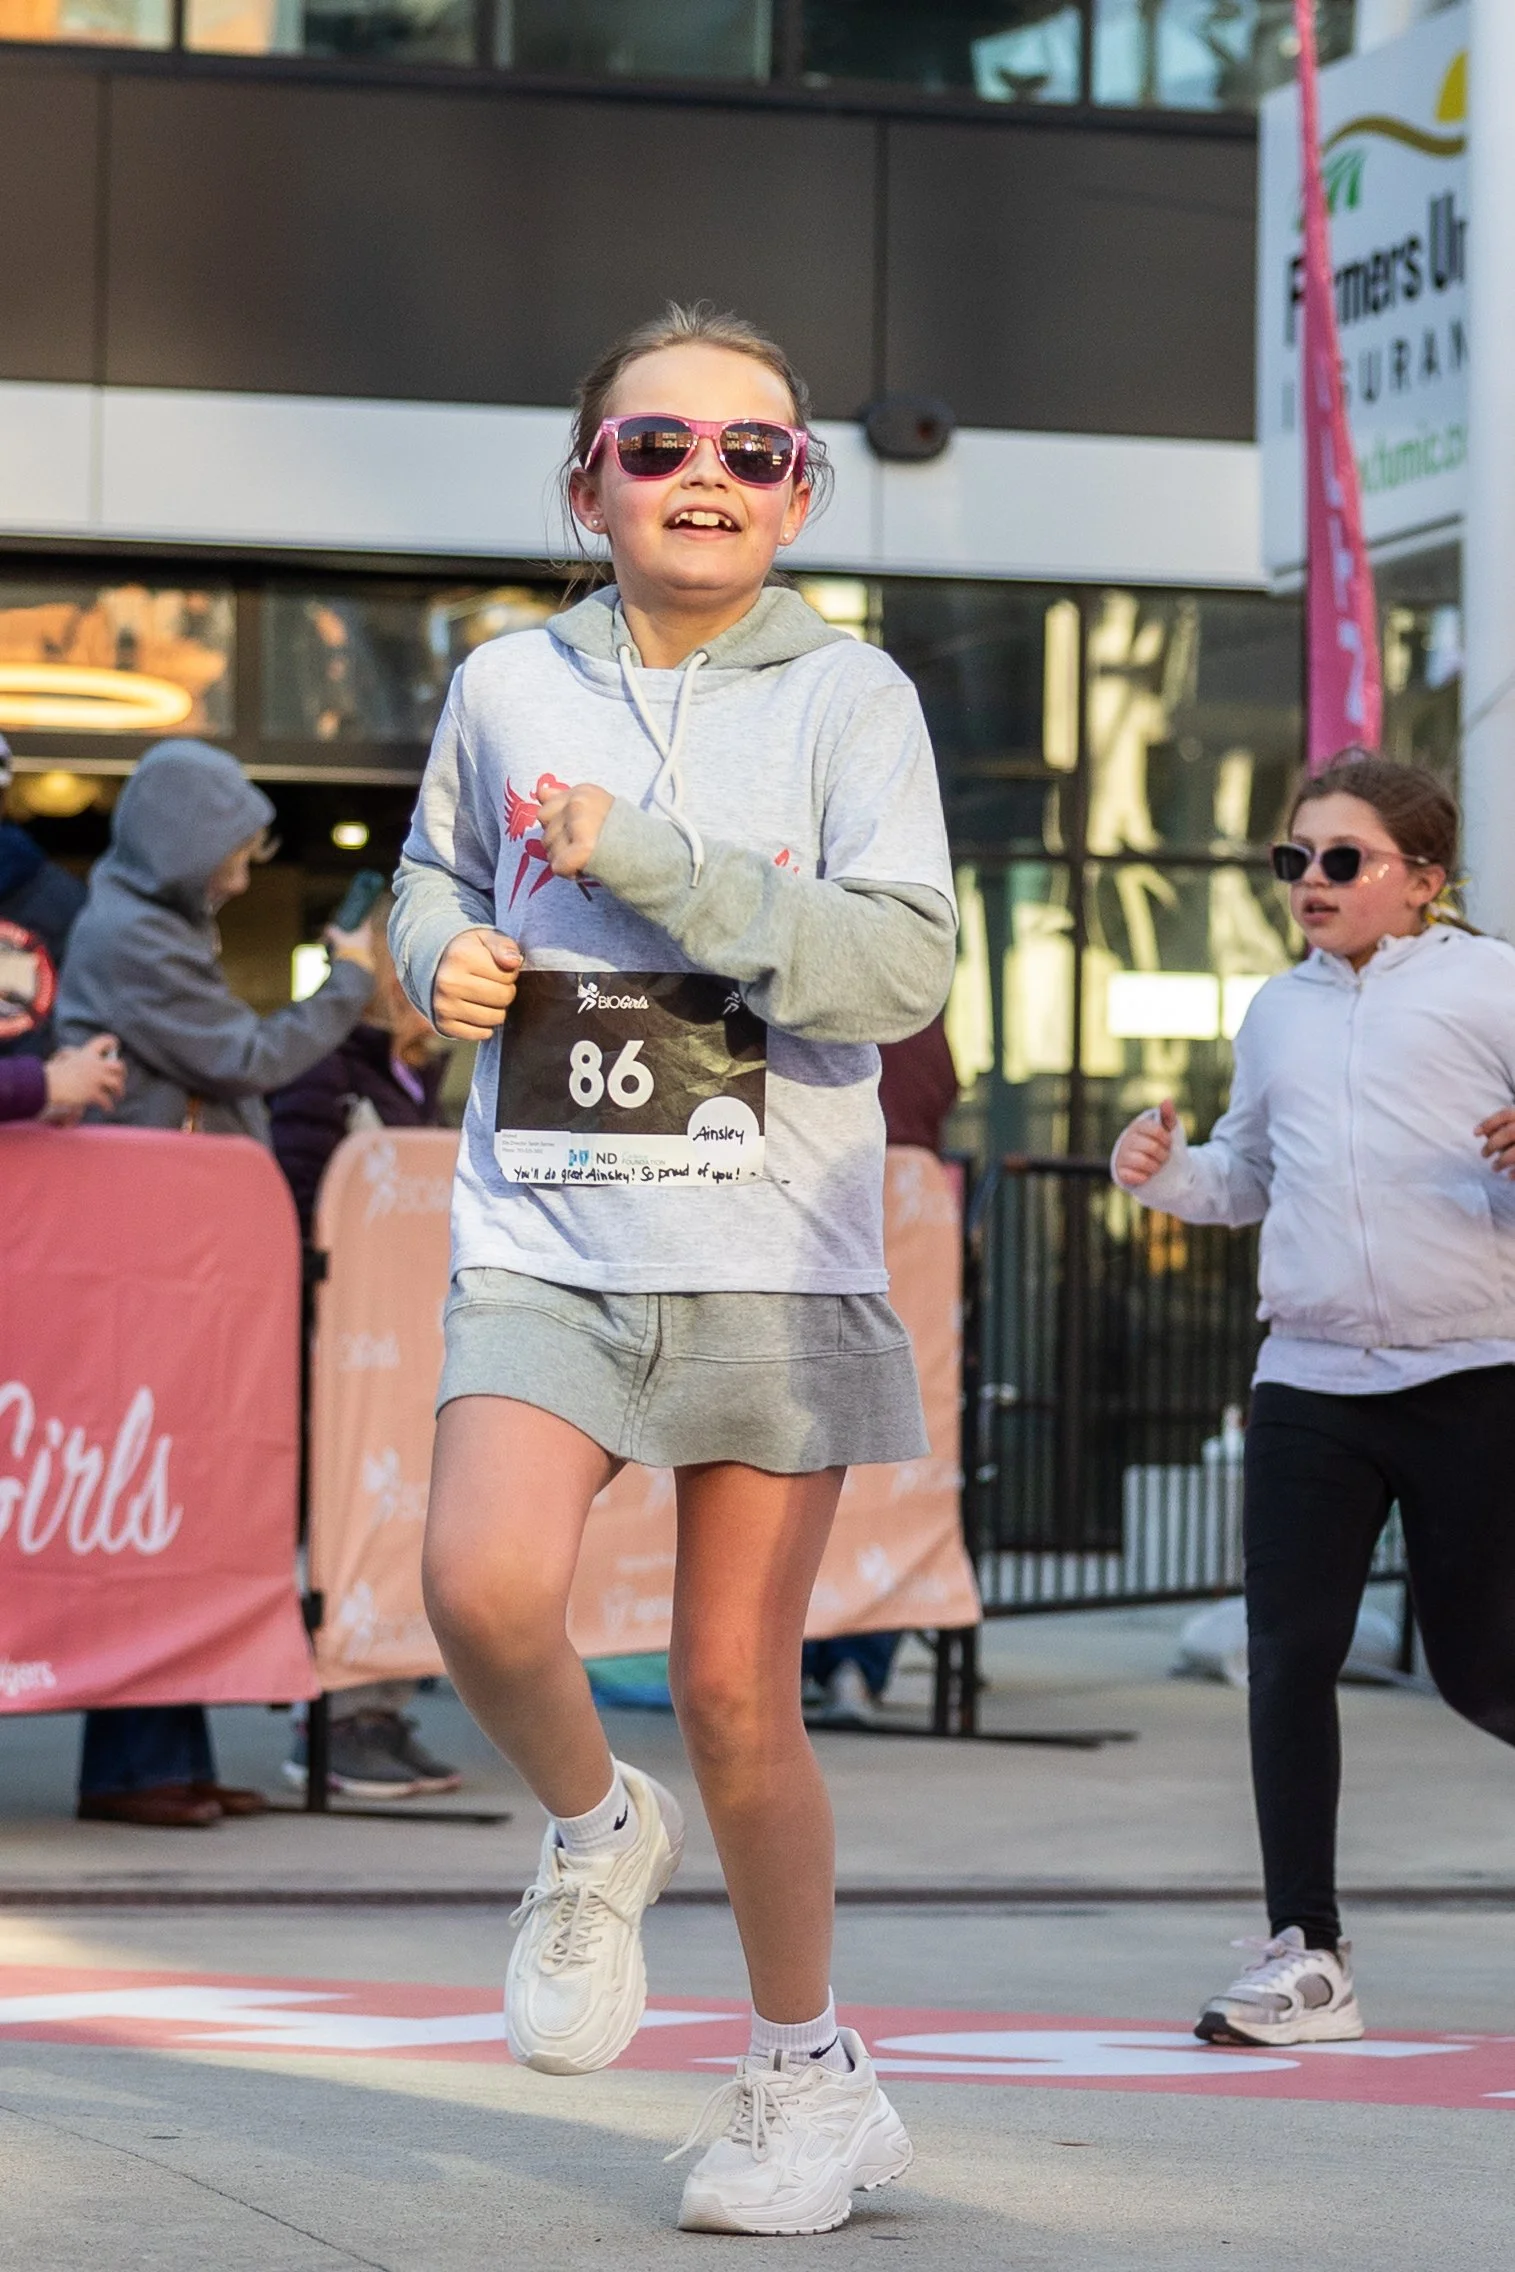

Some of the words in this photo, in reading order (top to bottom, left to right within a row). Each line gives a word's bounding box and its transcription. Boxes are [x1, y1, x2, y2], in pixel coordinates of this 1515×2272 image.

[1286, 233, 1422, 347] Fmers
[1282, 320, 1469, 431] IURAN
[569, 1040, 654, 1109] 86
[692, 1125, 744, 1145] Ainsley
[514, 1166, 539, 1181] You'll
[544, 1167, 556, 1180] do
[561, 1168, 584, 1184] great
[640, 1165, 654, 1182] So
[658, 1163, 689, 1182] proud
[697, 1162, 710, 1177] of
[712, 1167, 740, 1184] you!
[596, 1152, 618, 1165] ND
